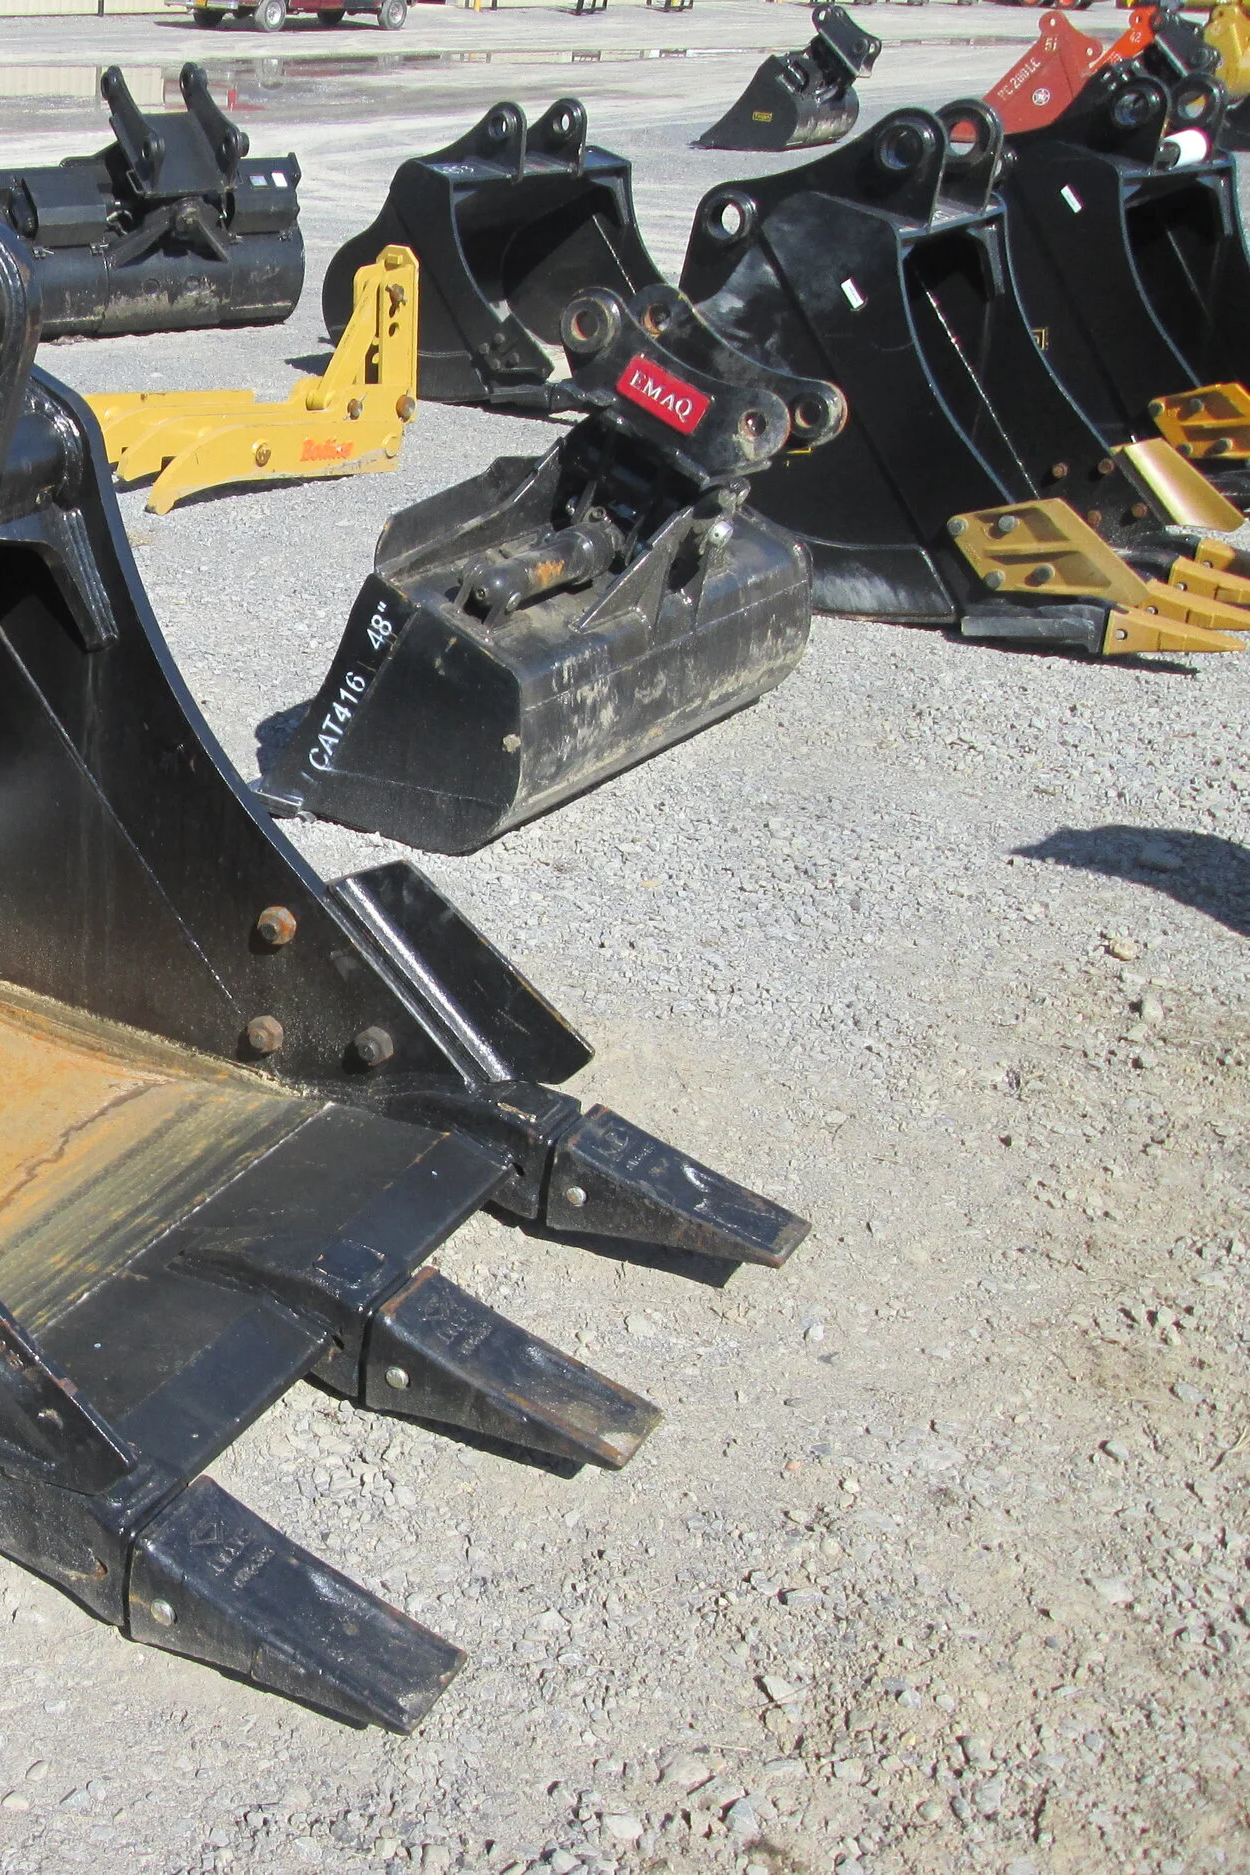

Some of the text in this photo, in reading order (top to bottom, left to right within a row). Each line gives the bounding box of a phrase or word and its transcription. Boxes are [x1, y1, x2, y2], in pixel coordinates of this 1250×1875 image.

[629, 369, 693, 423] EMAQ
[308, 601, 393, 771] CAT416 48"
